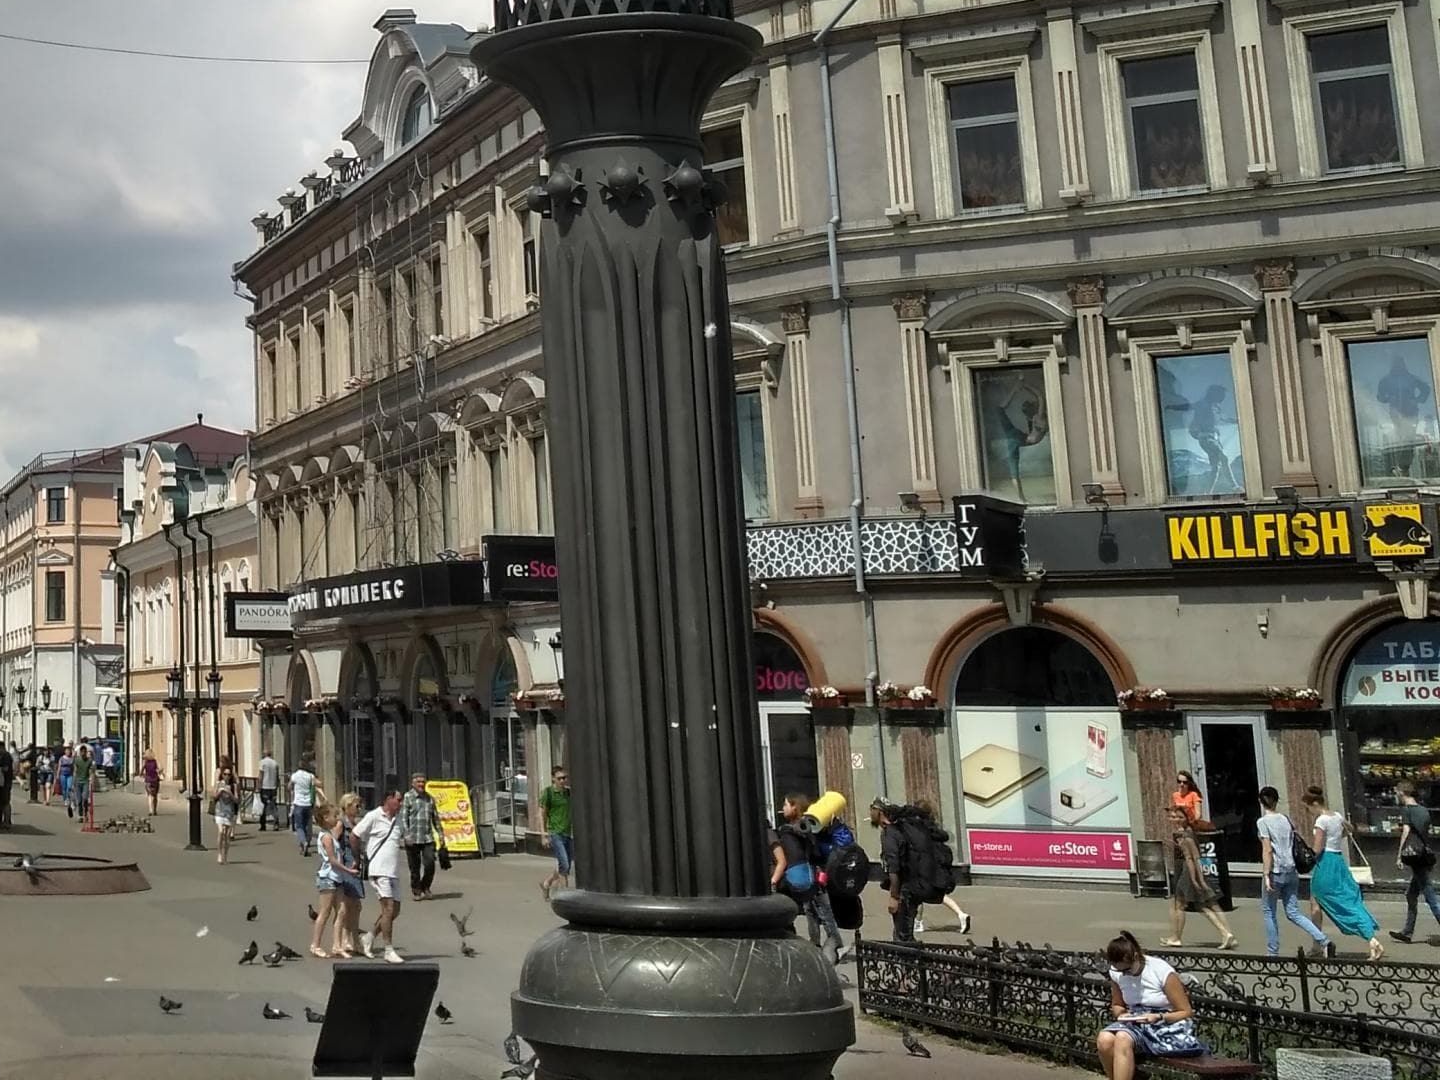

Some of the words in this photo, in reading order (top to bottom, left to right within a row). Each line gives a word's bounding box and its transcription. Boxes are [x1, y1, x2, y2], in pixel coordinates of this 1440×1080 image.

[1168, 511, 1351, 560] KILLFISH
[506, 561, 559, 578] re:Sto
[1383, 641, 1440, 659] ТАБ
[756, 665, 806, 691] Store
[1048, 841, 1098, 856] re:Store
